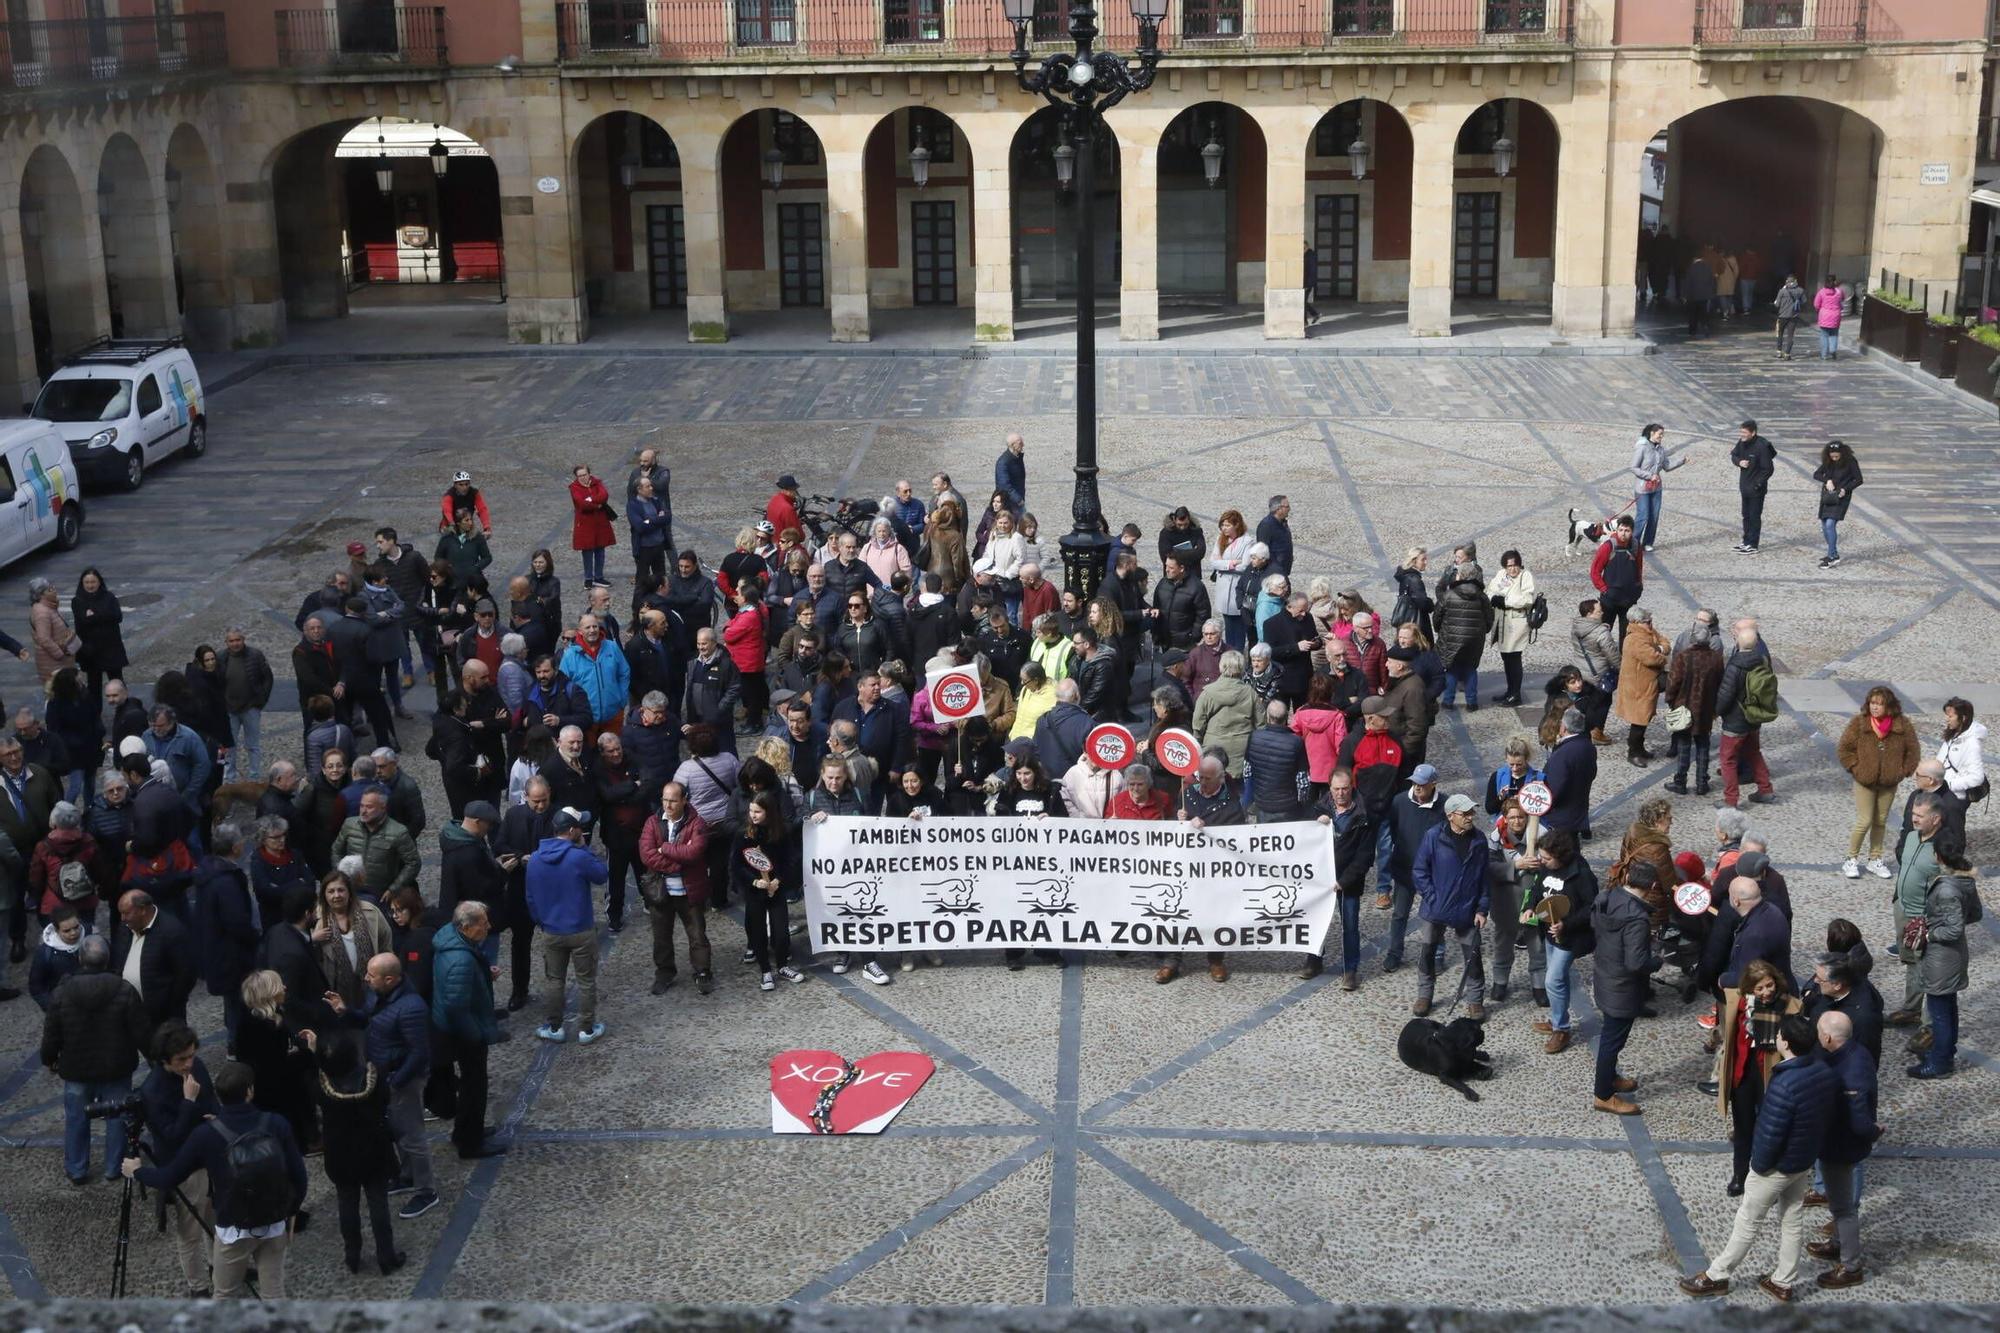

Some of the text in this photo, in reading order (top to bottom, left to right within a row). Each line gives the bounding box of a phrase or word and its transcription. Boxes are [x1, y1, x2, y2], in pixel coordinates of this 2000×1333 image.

[849, 825, 922, 844] TAMBIÉN
[927, 827, 986, 844] SOMOS
[991, 823, 1039, 844] GIJÓN
[1043, 828, 1053, 844] Y
[1058, 828, 1141, 846] PAGAMOS
[1249, 834, 1296, 853] PERO
[811, 855, 1315, 880] NO APARECEMOS EN PLANES, INVERSIONES NI PROYECTOS
[820, 918, 1311, 947] RESPETO PARA LA ZONA OESTE
